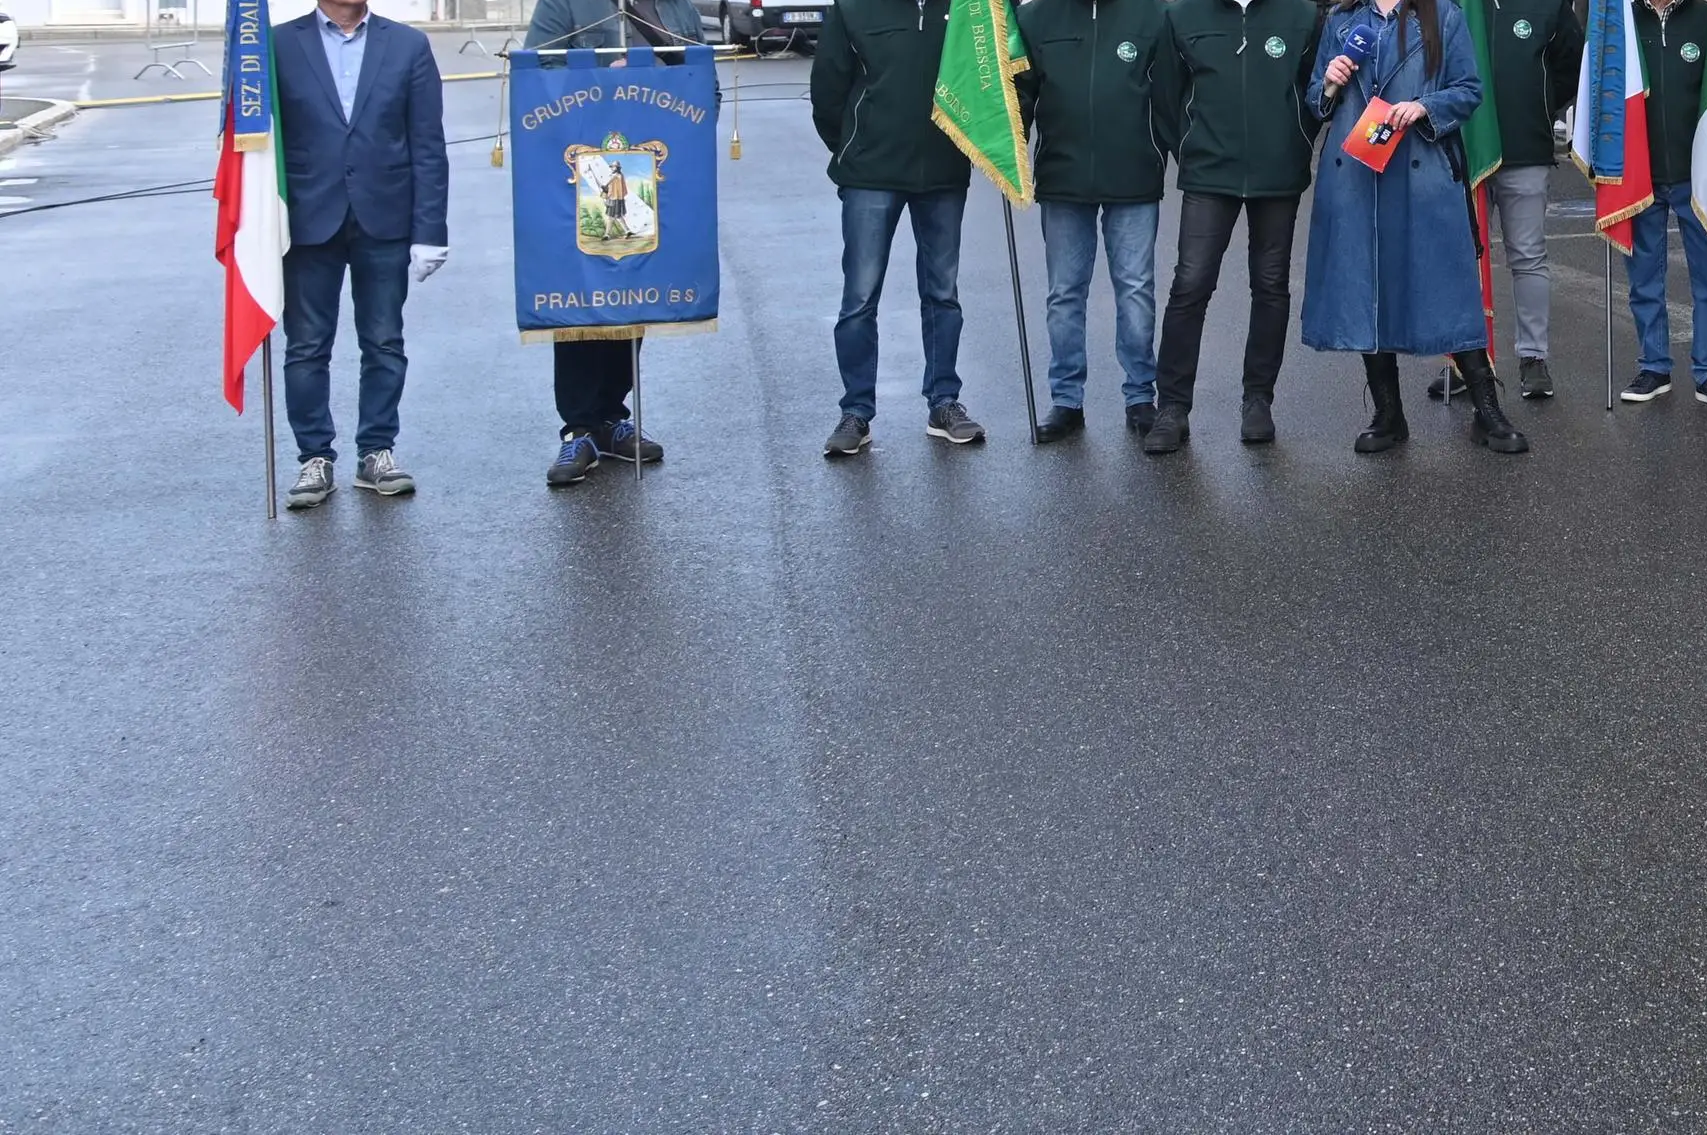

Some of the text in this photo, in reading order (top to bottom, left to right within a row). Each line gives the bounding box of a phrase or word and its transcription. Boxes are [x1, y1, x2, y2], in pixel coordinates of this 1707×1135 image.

[967, 1, 982, 16] DI
[240, 54, 260, 72] DI
[971, 24, 993, 92] BRESCIA
[522, 85, 707, 131] GRUPPO ARTIGIANI
[534, 287, 659, 311] PRALBOINO
